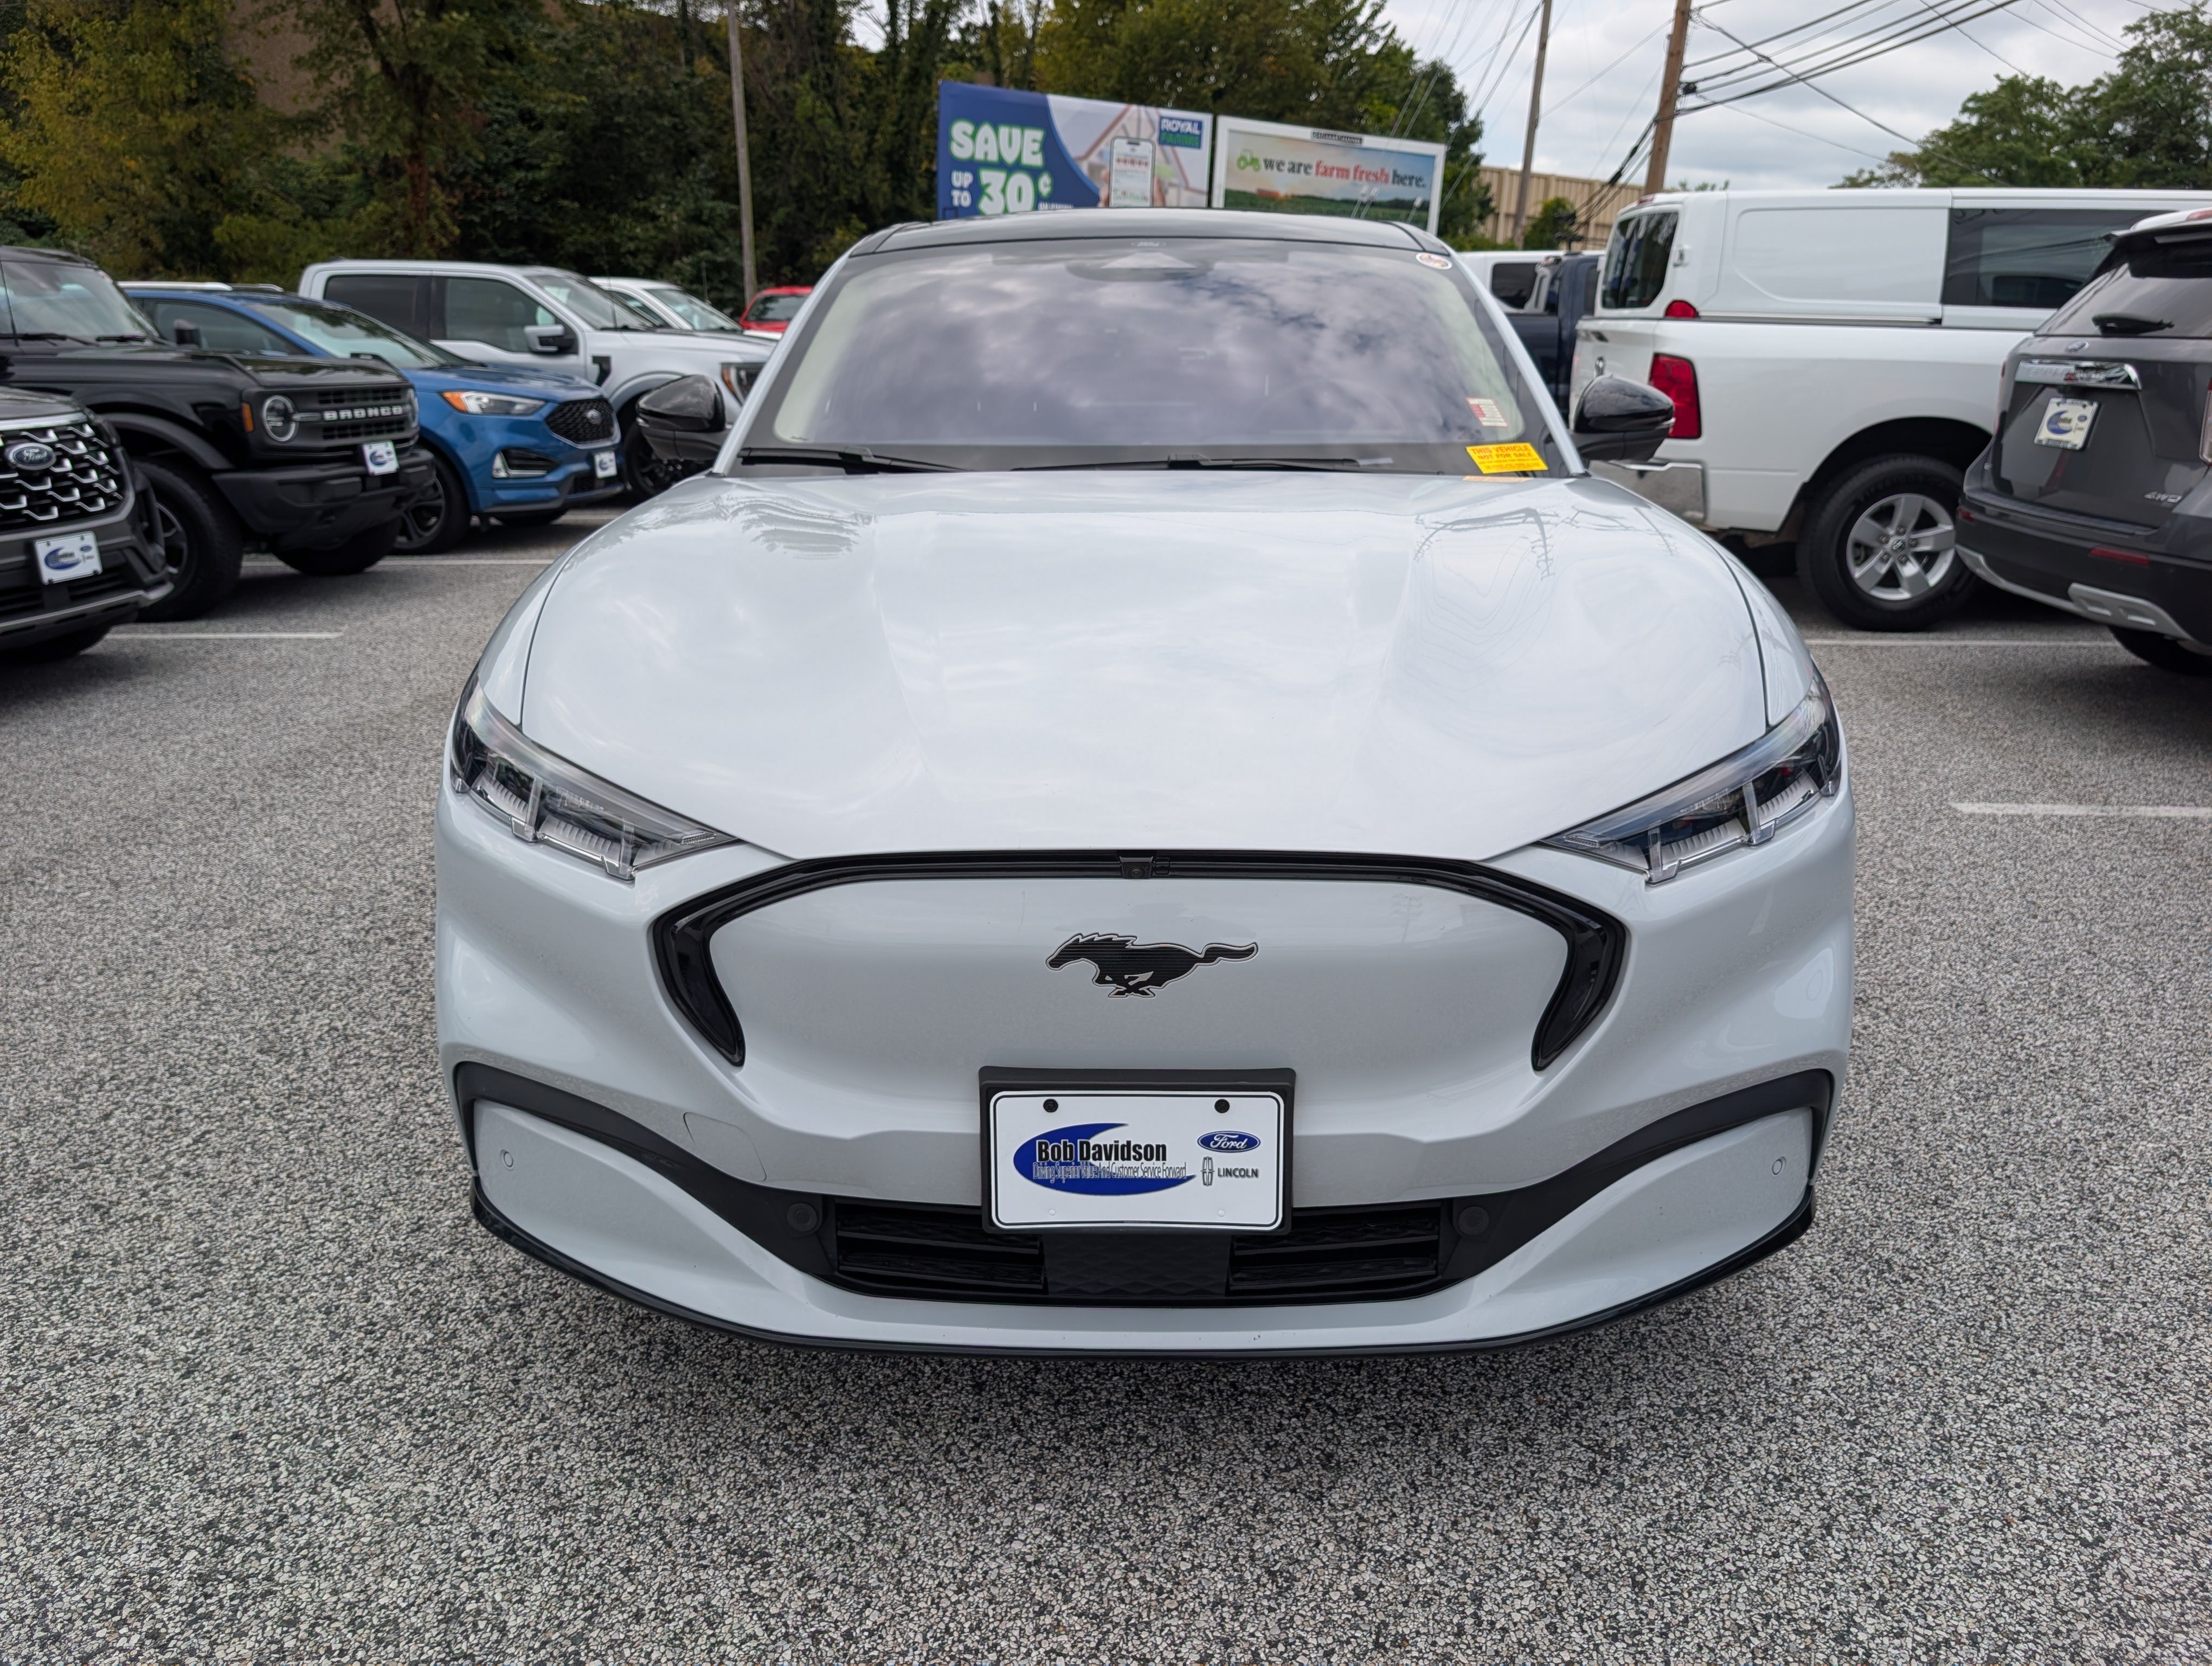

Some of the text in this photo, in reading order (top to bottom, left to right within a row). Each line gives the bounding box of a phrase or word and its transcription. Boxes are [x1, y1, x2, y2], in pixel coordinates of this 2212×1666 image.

[1161, 118, 1201, 136] ROYAL
[950, 119, 1045, 167] SAVE
[951, 170, 974, 188] UP
[1263, 158, 1426, 188] we are farm fresh here.
[951, 189, 972, 208] TO
[323, 405, 403, 421] BRONCO
[1495, 445, 1530, 453] VEHICLE
[1210, 1133, 1248, 1149] Ford
[1037, 1139, 1167, 1162] Bob Davidson
[1033, 1162, 1055, 1184] Driving
[1055, 1161, 1080, 1183] Superior
[1098, 1162, 1110, 1179] And
[1111, 1162, 1139, 1179] Customer
[1140, 1162, 1161, 1178] Service
[1162, 1162, 1187, 1179] Forward
[1217, 1167, 1259, 1178] LINCOLN
